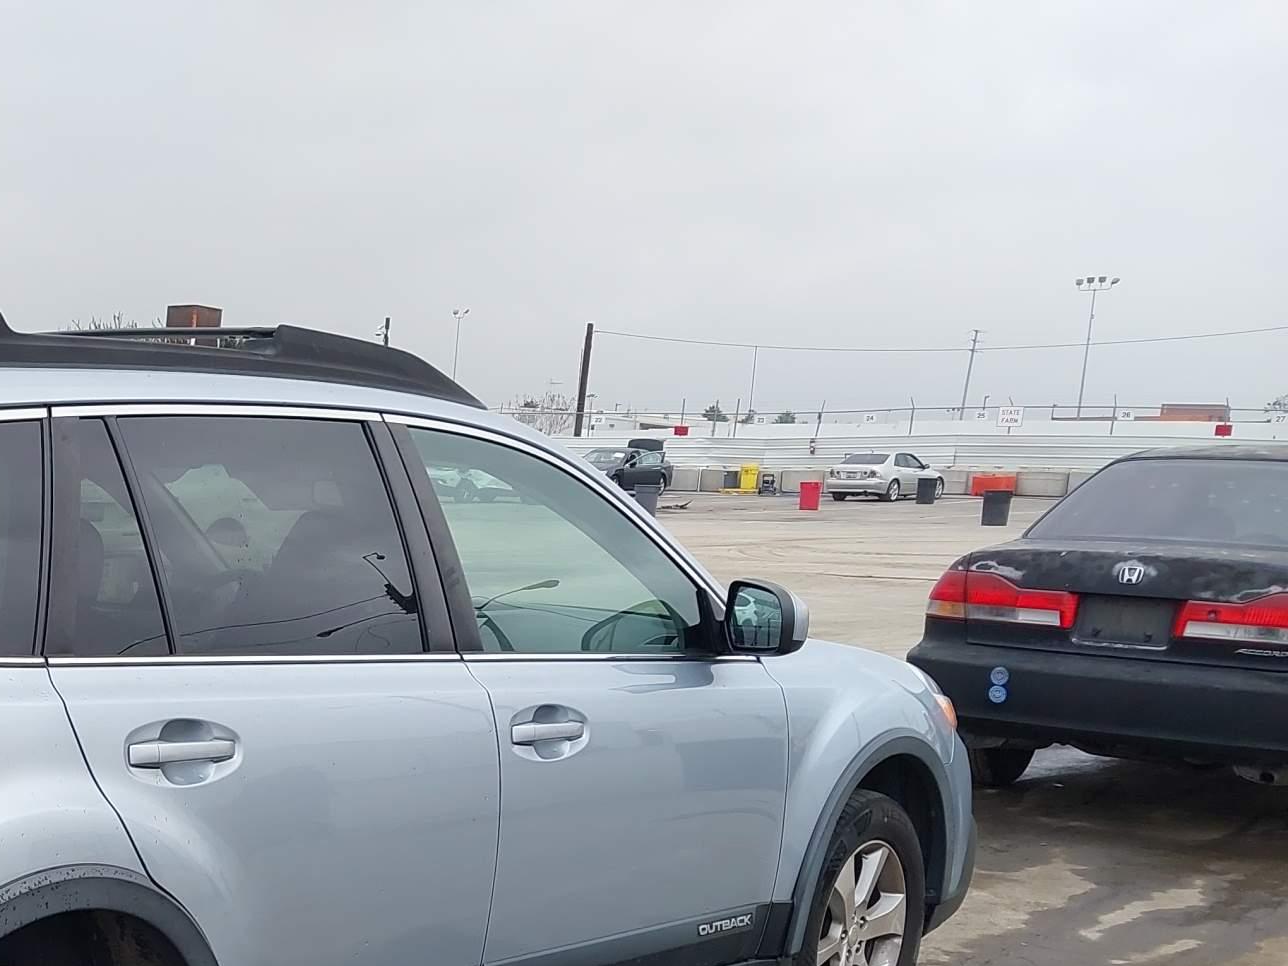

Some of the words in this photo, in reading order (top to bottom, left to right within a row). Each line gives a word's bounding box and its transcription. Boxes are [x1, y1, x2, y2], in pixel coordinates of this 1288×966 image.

[866, 415, 876, 423] 24
[1275, 415, 1287, 423] 27
[698, 913, 751, 936] OUTBACK
